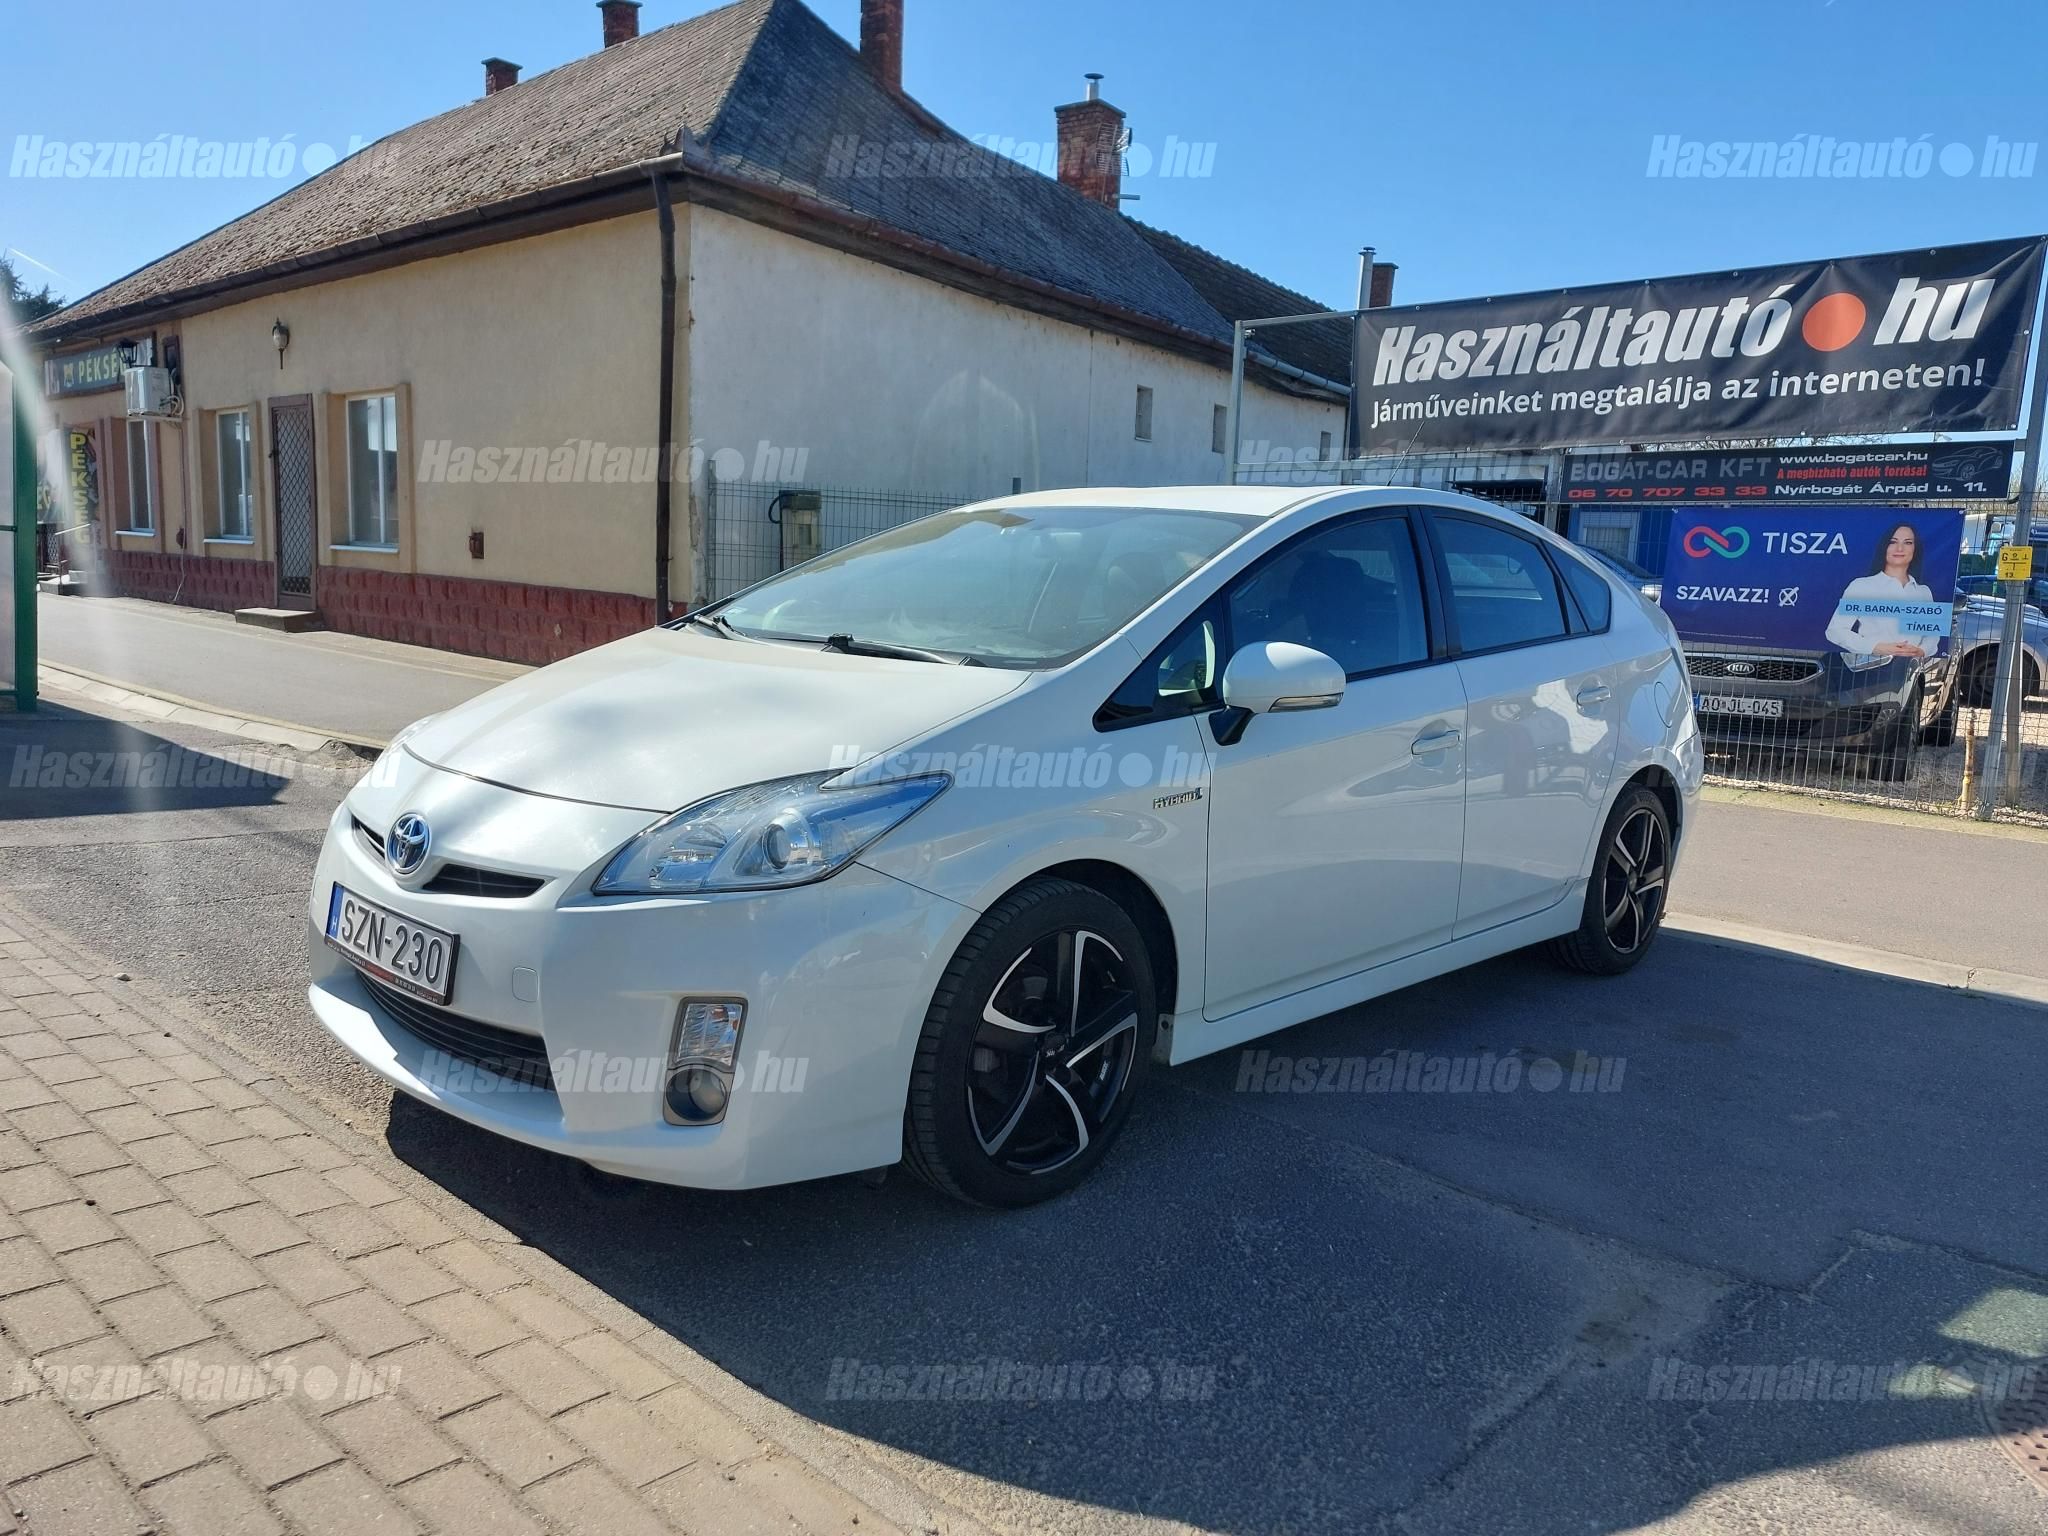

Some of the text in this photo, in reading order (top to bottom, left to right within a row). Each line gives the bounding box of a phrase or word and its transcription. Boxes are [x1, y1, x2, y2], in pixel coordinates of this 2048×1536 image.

[1372, 276, 1996, 386] Használtautó hu
[1371, 357, 1984, 428] Járműveinket megtalálja az interneten!
[1779, 452, 1929, 464] www.bogatcar.hu
[1570, 457, 1771, 481] BOGÁT-CAR KFT
[1776, 468, 1784, 480] A
[1850, 466, 1881, 478] autók
[1569, 486, 1768, 498] 06 70 707 33 33
[1774, 481, 1987, 495] Nyírbogát Árpád u. 11.
[1762, 532, 1848, 555] TISZA
[1676, 585, 1769, 604] SZAVAZZ!
[1845, 603, 1943, 616] DR. BARNA-SZABÓ
[1906, 620, 1940, 633] TÍMEA
[341, 899, 444, 984] SZN-230
